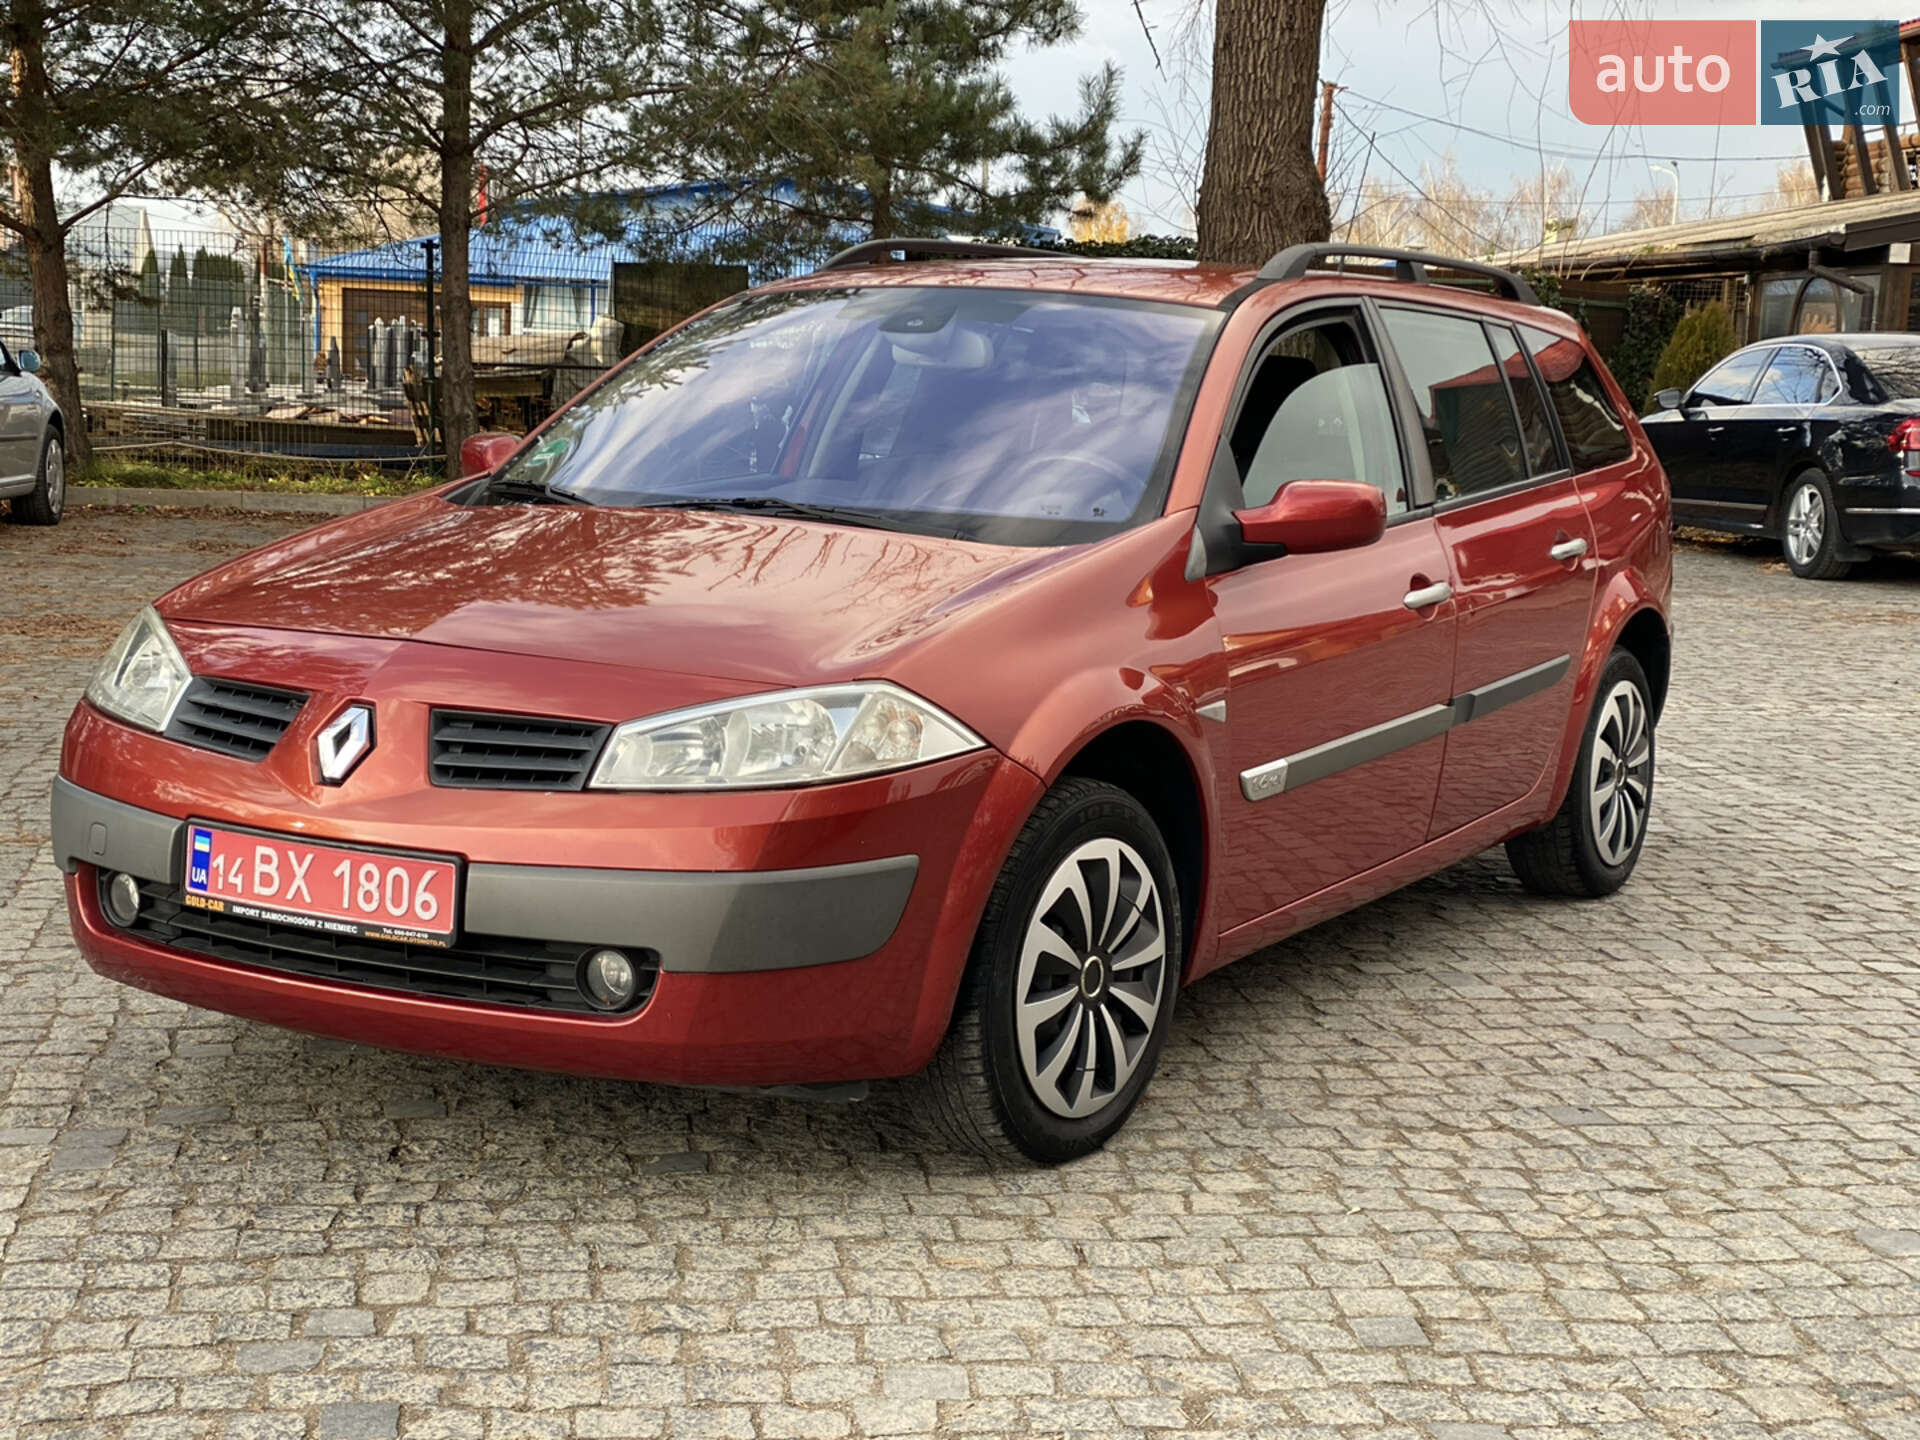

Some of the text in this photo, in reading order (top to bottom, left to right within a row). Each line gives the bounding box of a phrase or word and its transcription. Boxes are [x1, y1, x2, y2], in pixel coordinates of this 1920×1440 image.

[191, 866, 208, 885] UA
[212, 845, 439, 922] 14 BX 1806
[185, 895, 225, 912] GOLD-CAR
[232, 905, 359, 934] IMPORT SAMOCHODÓW Z NIEMIEC
